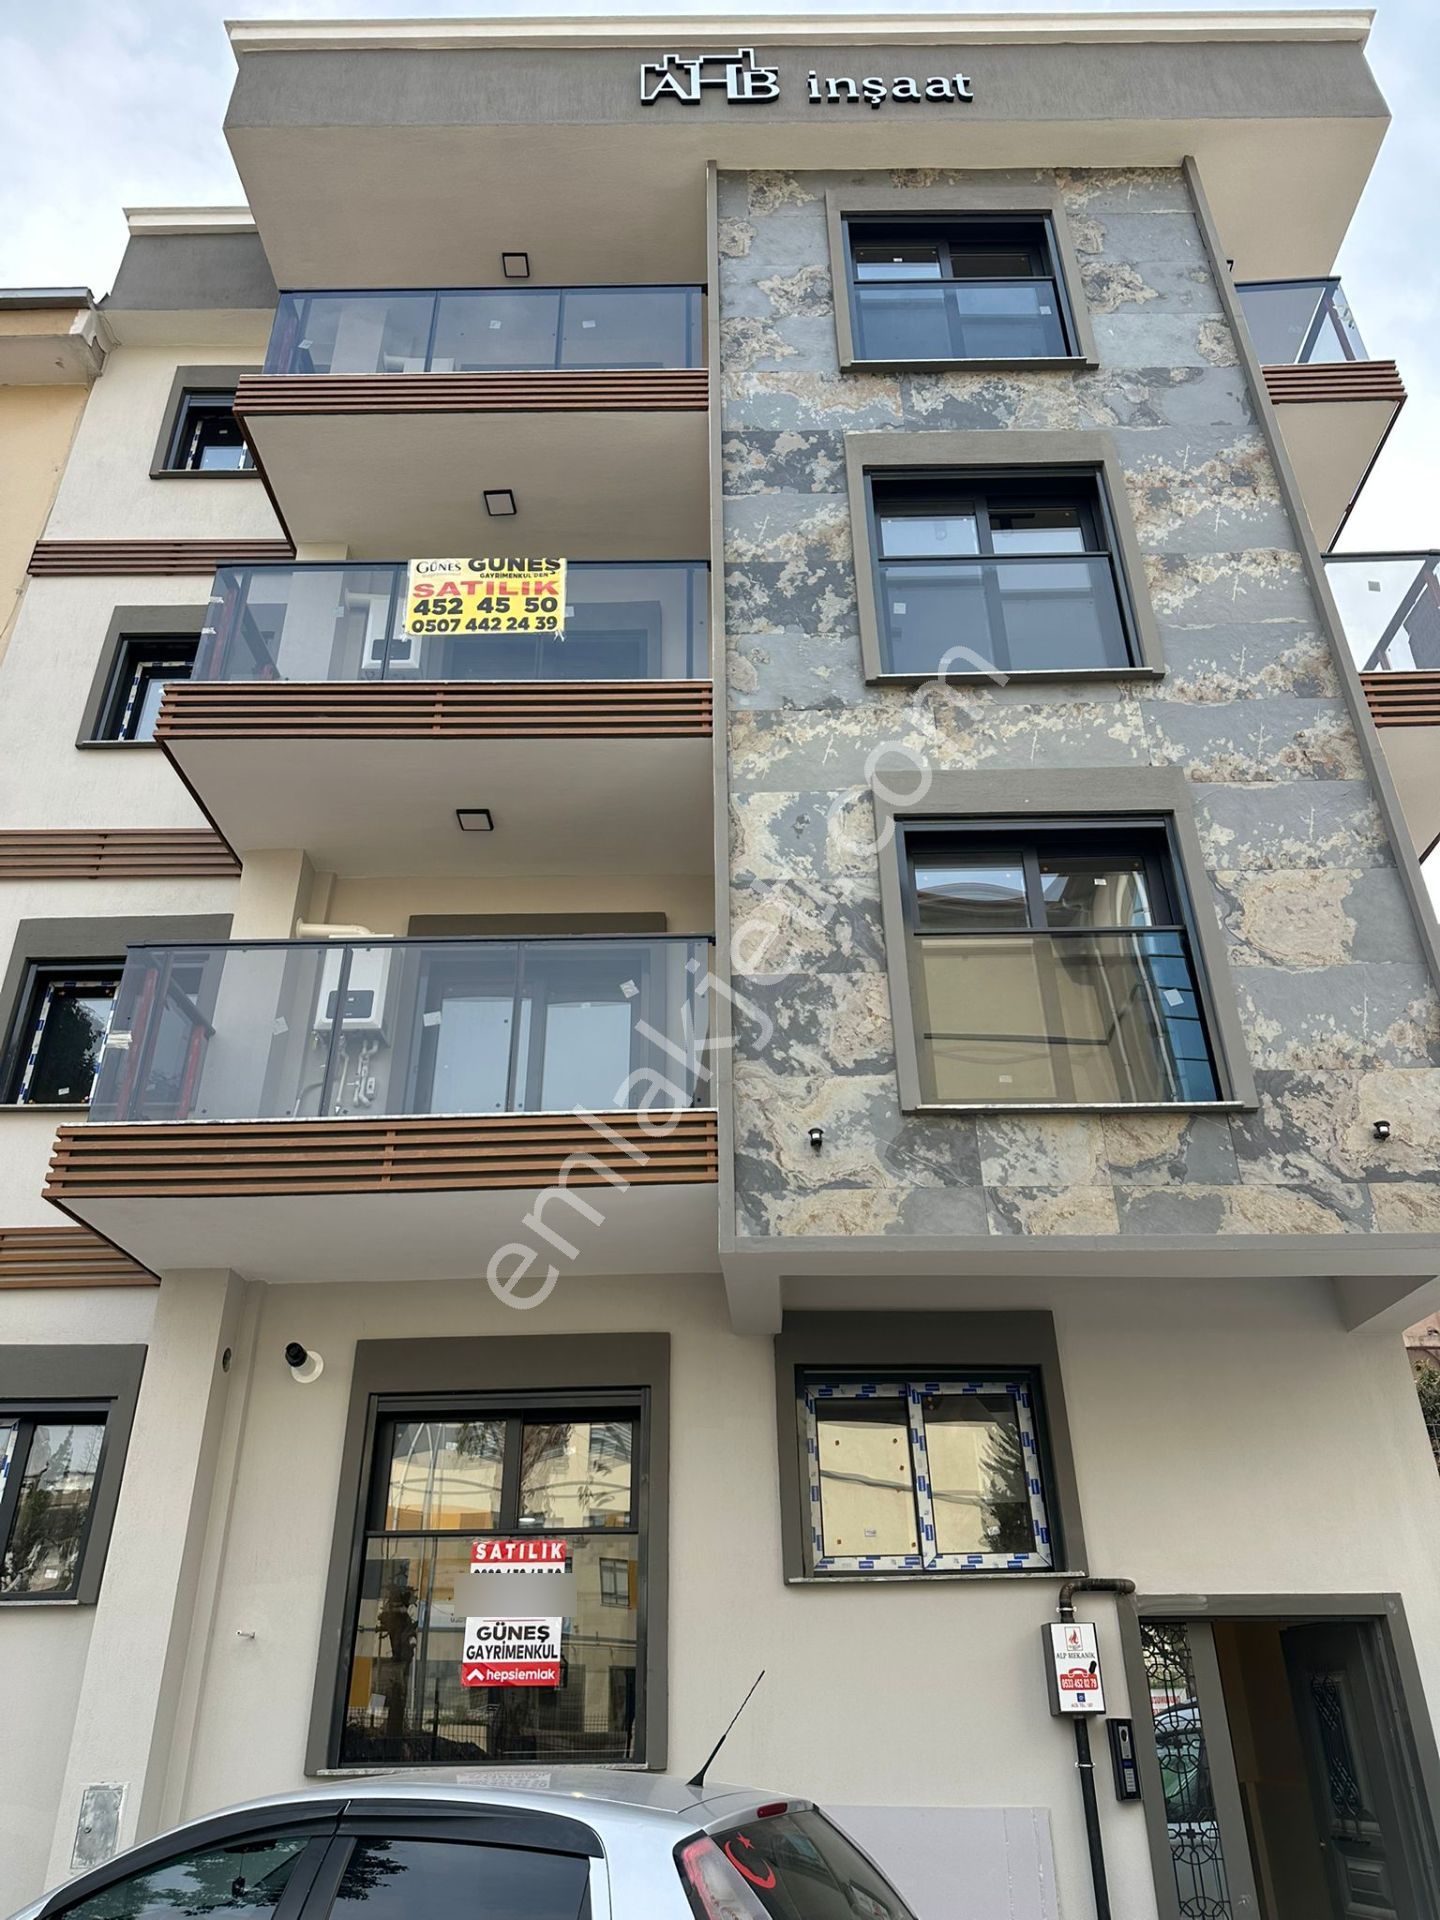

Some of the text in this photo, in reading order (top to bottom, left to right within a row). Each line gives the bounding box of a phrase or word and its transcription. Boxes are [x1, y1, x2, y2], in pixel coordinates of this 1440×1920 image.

[806, 70, 975, 108] inşaat
[413, 580, 560, 598] SATILIK
[413, 597, 558, 615] 452 45 50
[412, 616, 558, 633] 0507 442 24 39
[475, 1542, 563, 1560] SATILIK
[476, 1622, 550, 1643] GÜNEŞ
[466, 1640, 558, 1660] GAYRİMENKUL
[486, 1668, 555, 1682] hepsiemlak
